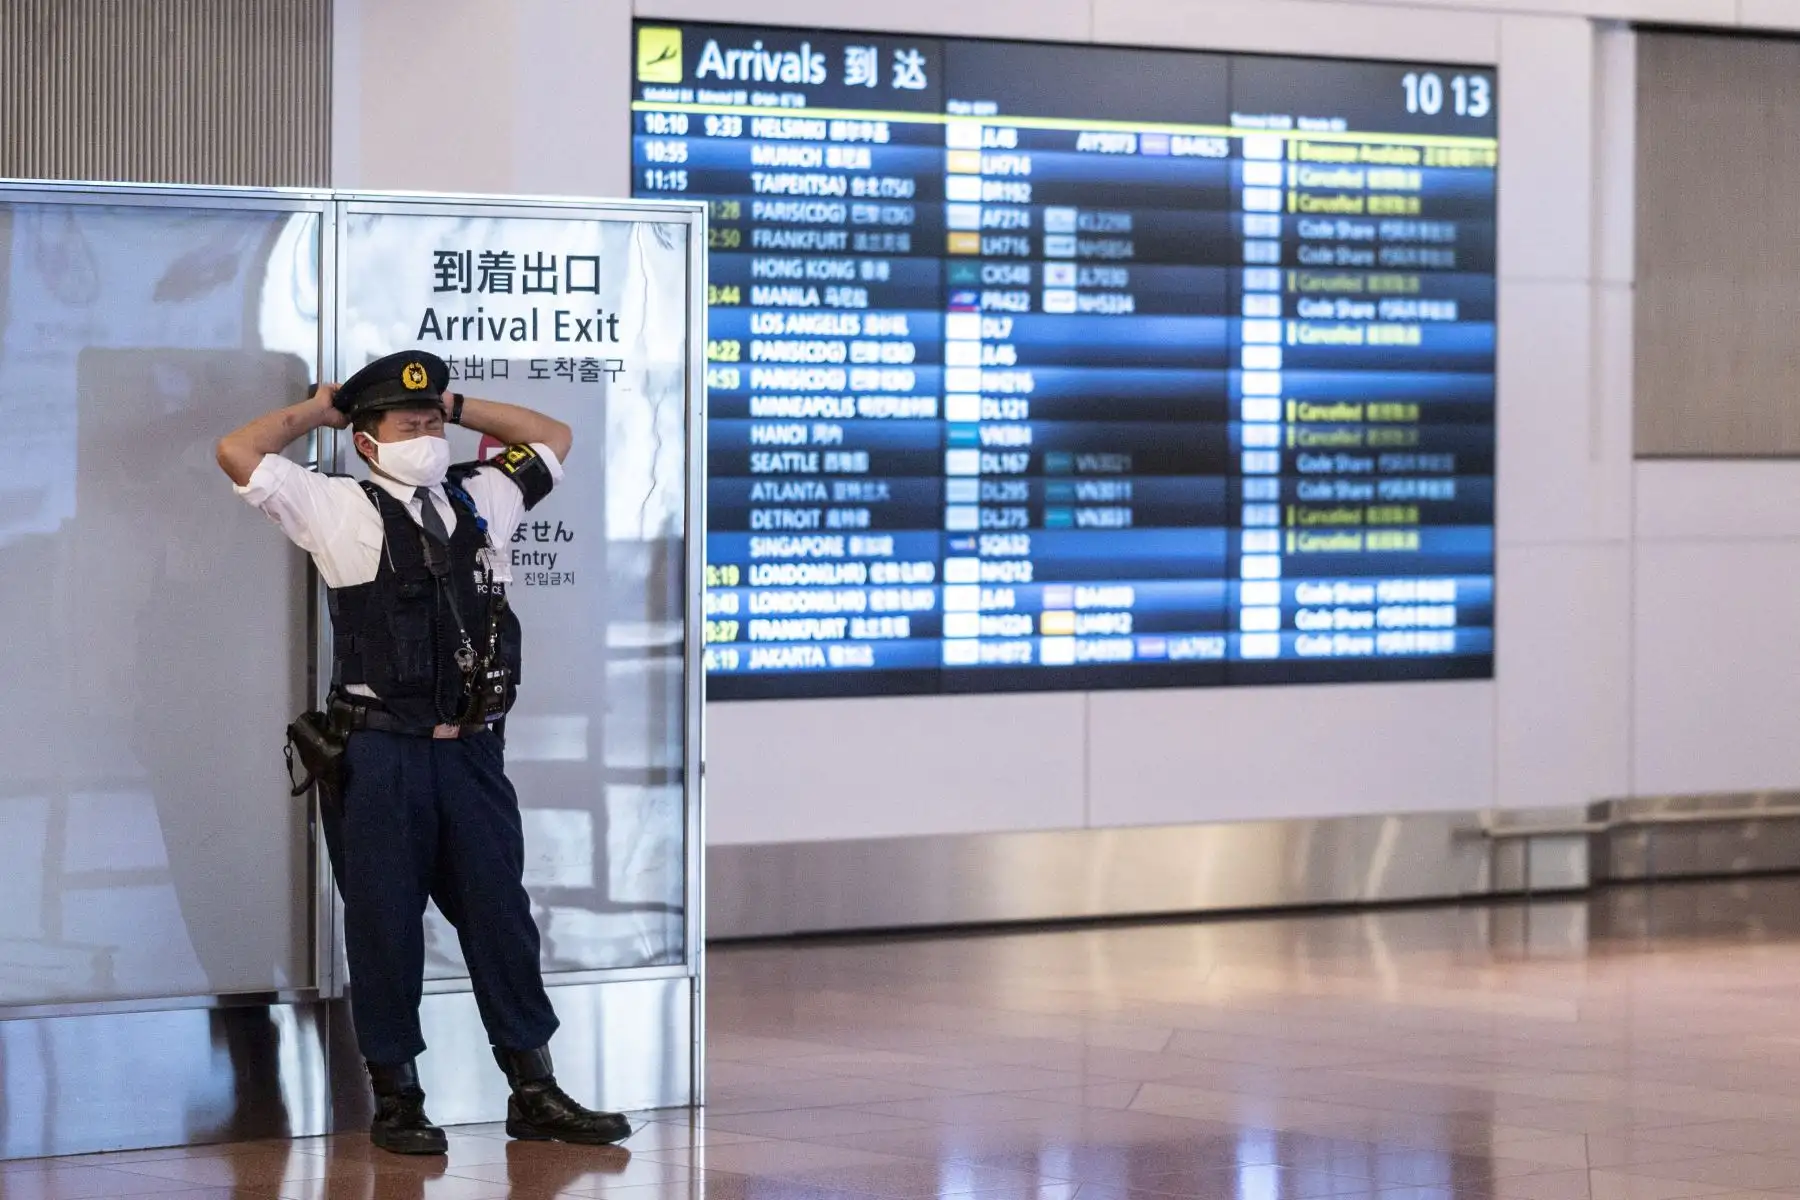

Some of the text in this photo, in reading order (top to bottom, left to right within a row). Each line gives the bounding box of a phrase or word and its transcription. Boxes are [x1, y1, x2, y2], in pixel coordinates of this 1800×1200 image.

[696, 40, 827, 84] Arrivals
[844, 46, 926, 89] 到 达
[1402, 72, 1490, 117] 10 13
[645, 113, 688, 135] 10:10
[645, 170, 688, 191] 11:15
[753, 231, 848, 250] FRANKFURT
[433, 249, 601, 295] 到着出口
[753, 260, 803, 279] HONG
[806, 261, 855, 280] KONG
[751, 286, 820, 306] MANILA
[417, 306, 620, 343] Arrival Exit
[752, 313, 784, 334] LOS
[527, 356, 626, 383] 도착출구
[751, 424, 807, 445] HANOI
[751, 451, 818, 473] SEATTLE
[752, 480, 828, 500] ATLANTA
[752, 508, 822, 529] DETROIT
[751, 536, 844, 557] SINGAPORE
[511, 549, 558, 570] Entry
[524, 572, 576, 586] 진입금지
